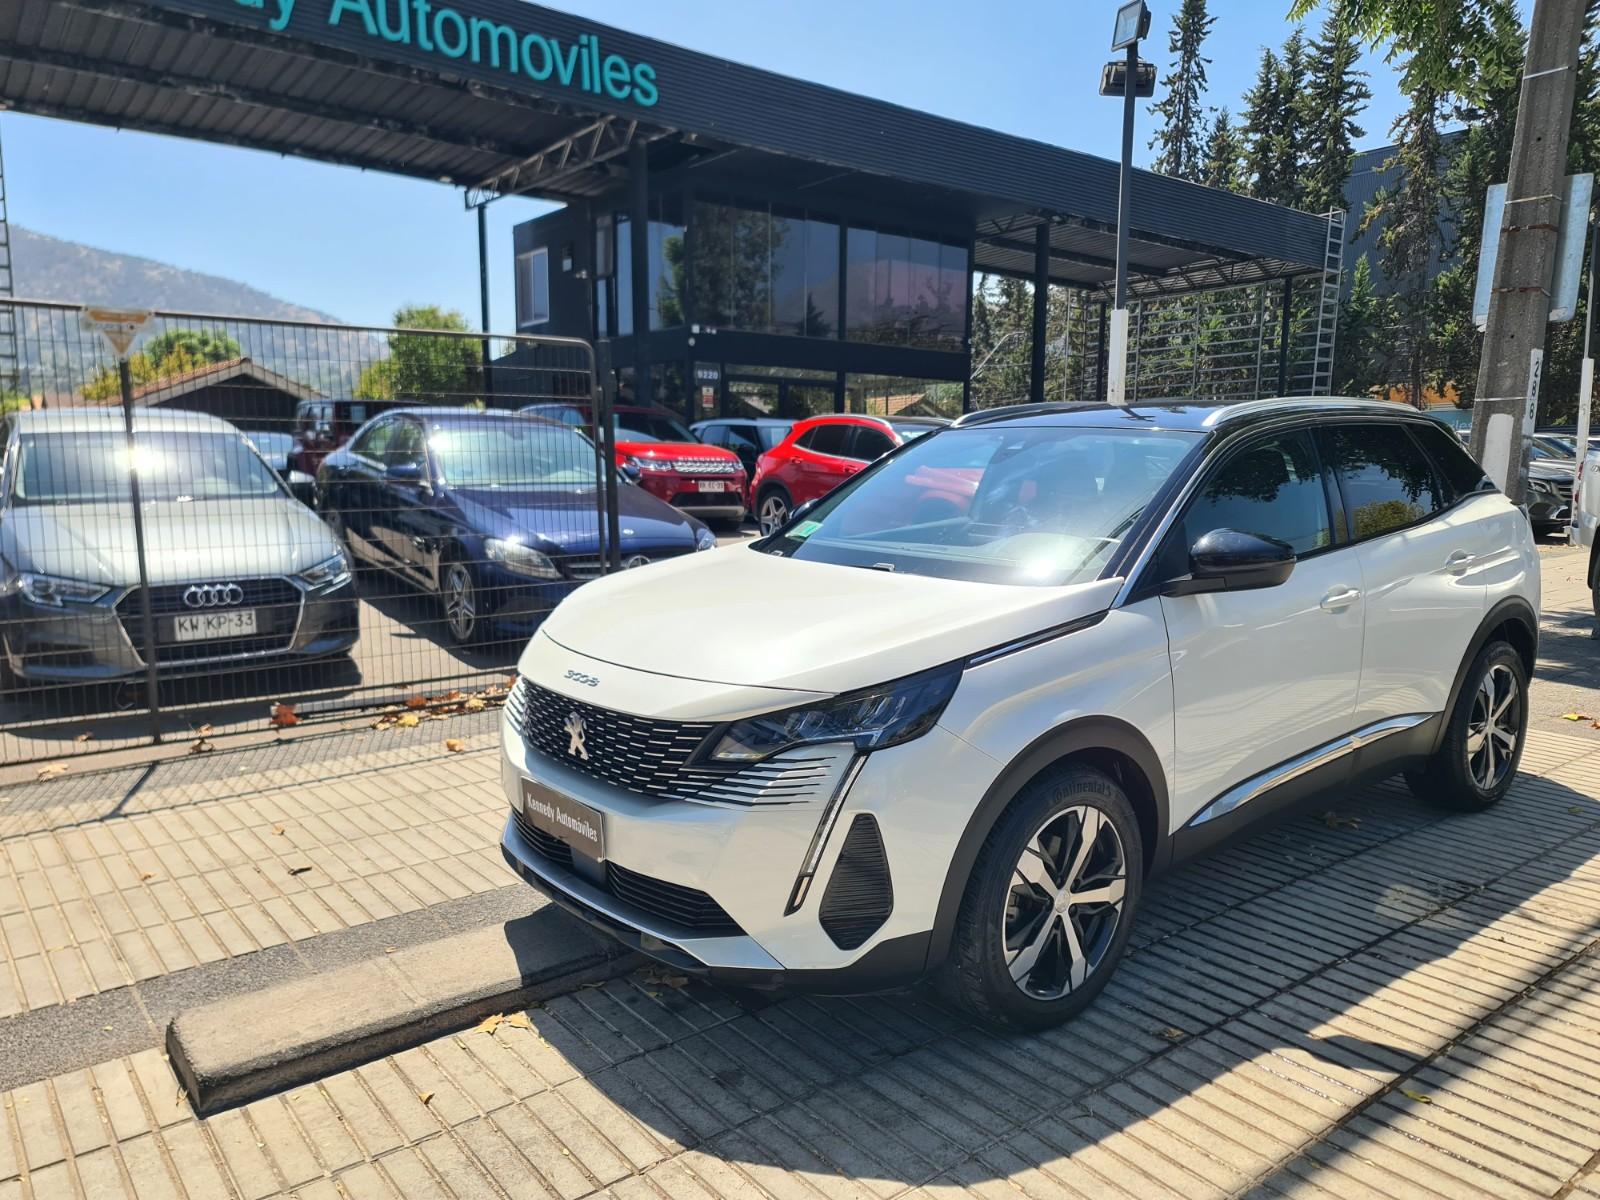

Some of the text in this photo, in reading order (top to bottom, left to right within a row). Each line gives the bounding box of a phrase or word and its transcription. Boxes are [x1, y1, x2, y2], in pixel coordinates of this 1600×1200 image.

[328, 0, 658, 106] Automoviles
[527, 792, 598, 842] Kennedy Automóviles
